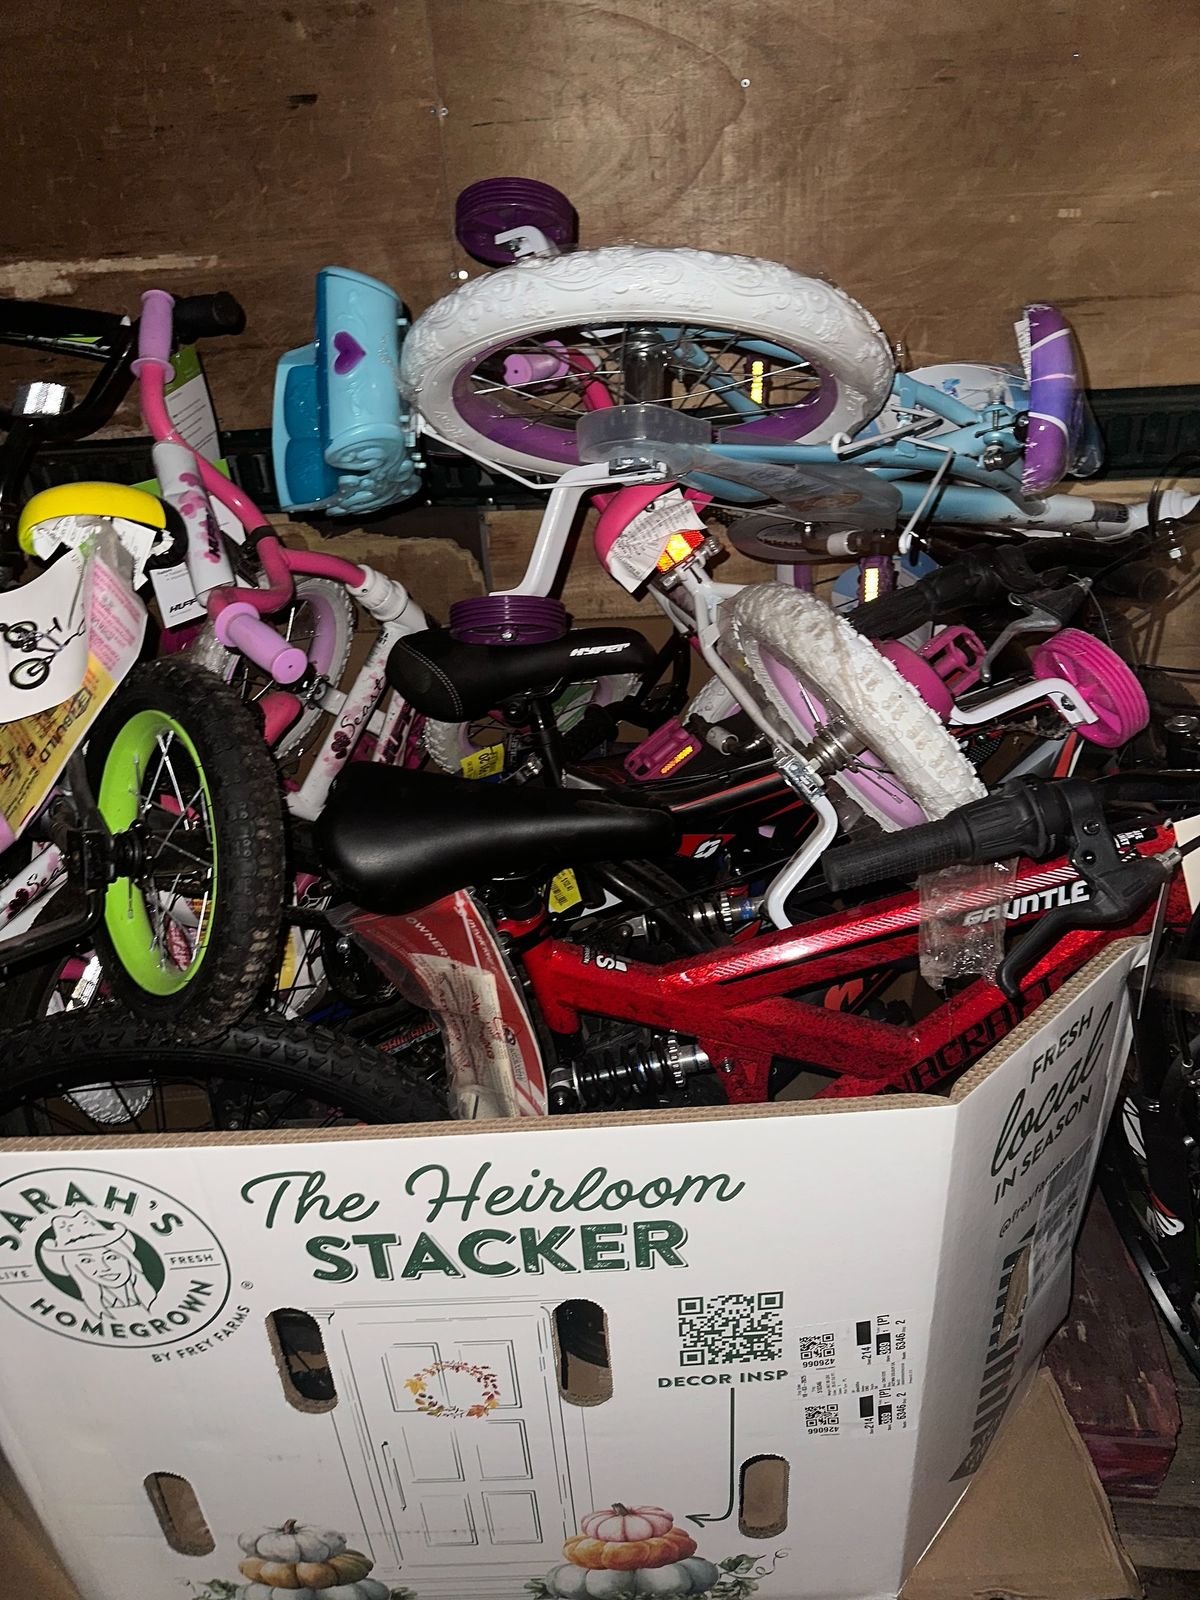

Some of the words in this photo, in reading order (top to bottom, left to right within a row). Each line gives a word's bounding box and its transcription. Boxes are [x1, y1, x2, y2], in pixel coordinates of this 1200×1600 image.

[170, 597, 198, 613] HUFF
[962, 880, 1090, 927] GAUNTLE
[883, 977, 1051, 1094] NACRAFT
[1030, 1006, 1095, 1084] FRESH
[990, 1001, 1114, 1177] local
[993, 1166, 1018, 1205] IN
[1020, 1085, 1093, 1177] SEASON
[240, 1169, 380, 1229] The
[404, 1161, 747, 1223] Heirloom
[170, 1253, 214, 1265] FRESH
[305, 1218, 690, 1282] STACKER
[30, 1279, 215, 1339] HOMEGROWN
[152, 1353, 172, 1364] BY
[176, 1338, 212, 1360] FREY
[213, 1304, 250, 1341] FARMS
[895, 1332, 906, 1351] 6346
[802, 1359, 836, 1369] 426066
[861, 1346, 872, 1360] 214
[657, 1371, 731, 1389] DECOR
[739, 1367, 789, 1385] INSP
[864, 1417, 874, 1430] 214
[896, 1403, 907, 1421] 6346
[807, 1426, 840, 1435] 426066
